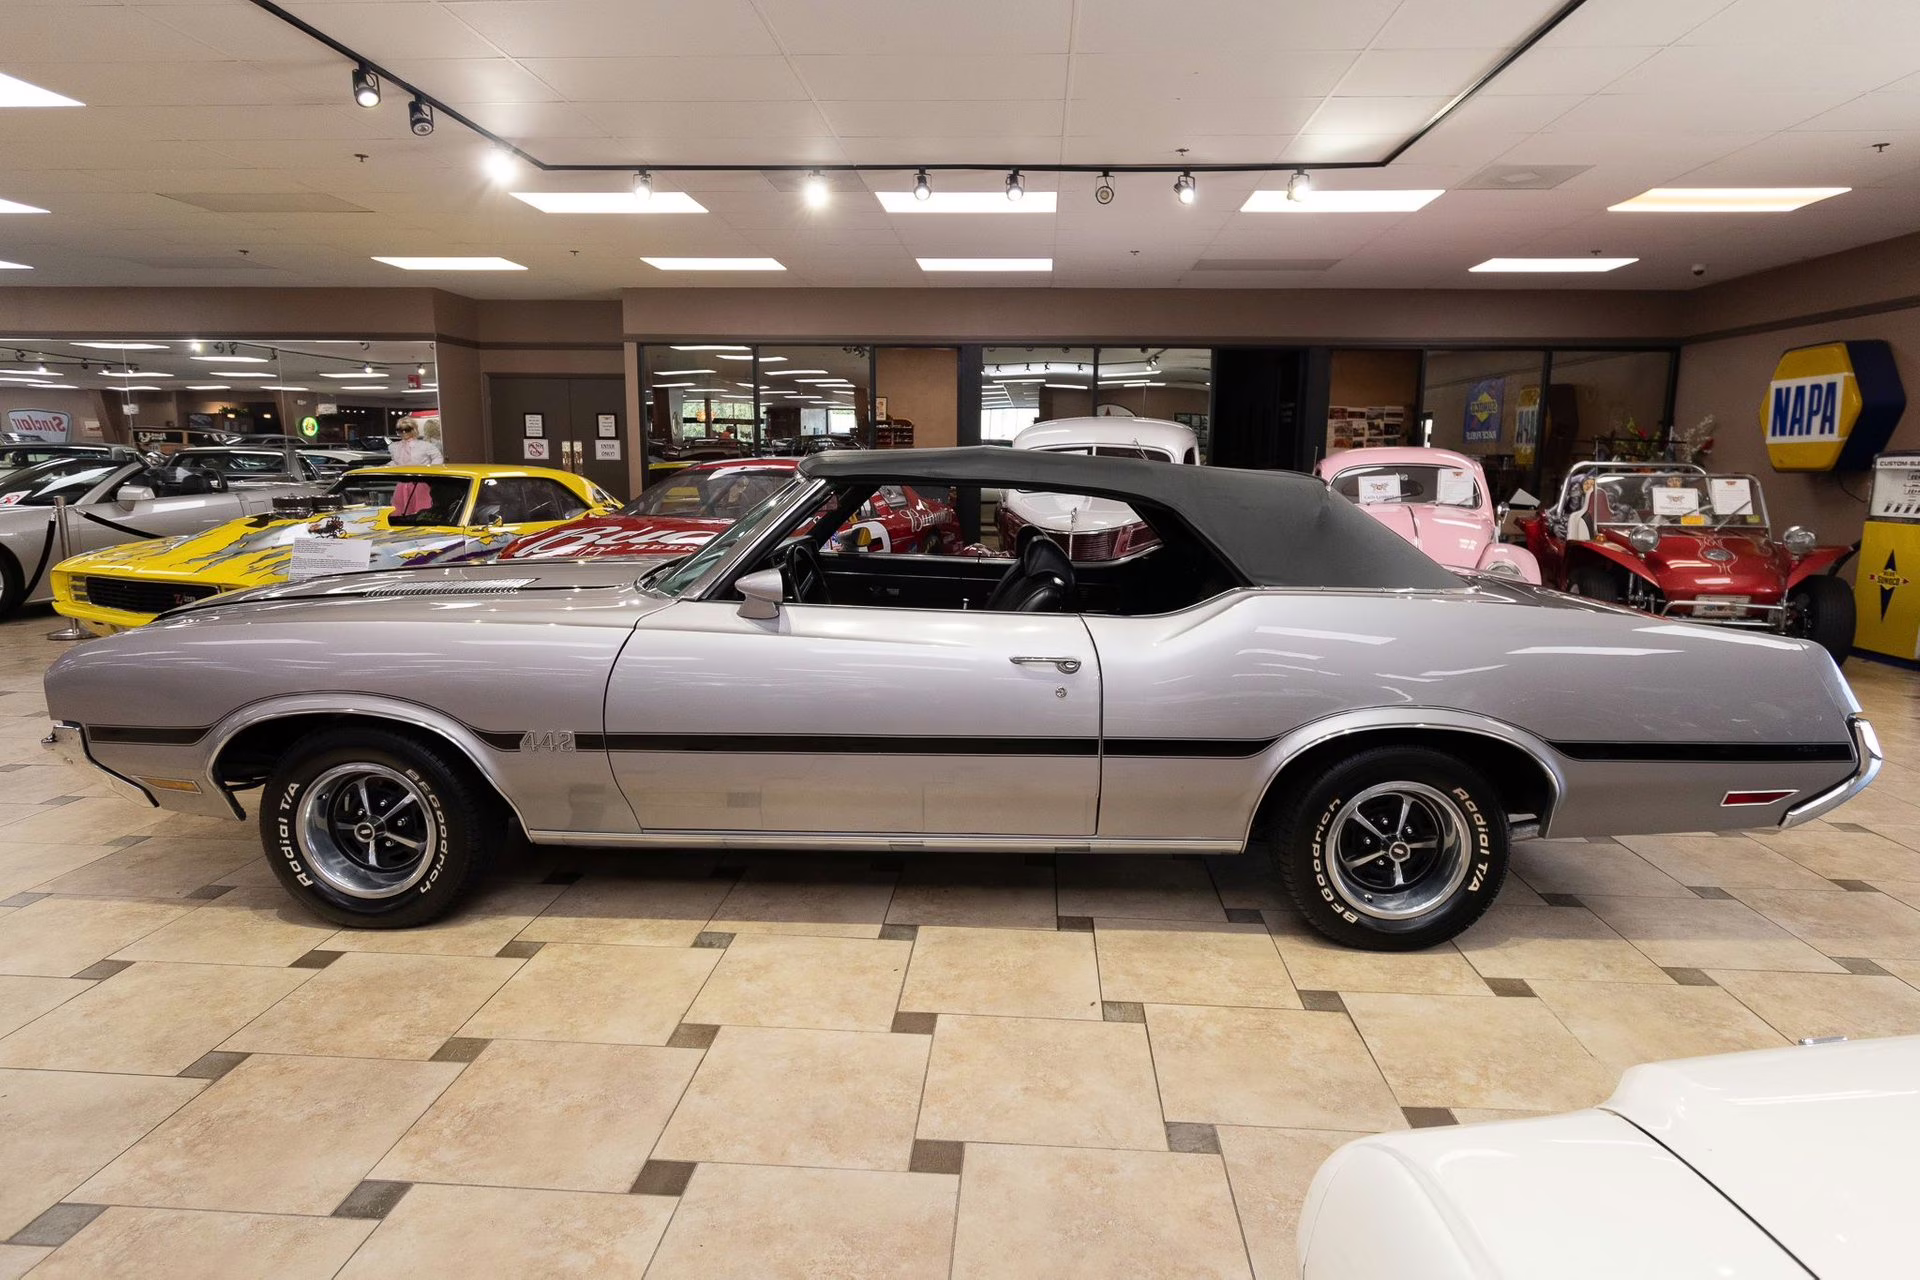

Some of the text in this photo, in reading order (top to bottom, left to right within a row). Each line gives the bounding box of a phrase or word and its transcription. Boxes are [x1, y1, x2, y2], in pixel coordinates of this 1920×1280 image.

[1771, 381, 1838, 437] NAPA
[1877, 575, 1900, 586] SUNOCO
[520, 730, 574, 752] 442
[277, 782, 313, 887] Radial T/A
[405, 768, 448, 895] BFGoodrich
[1312, 798, 1360, 924] BFGoodrich
[1452, 787, 1490, 892] Radial T/A
